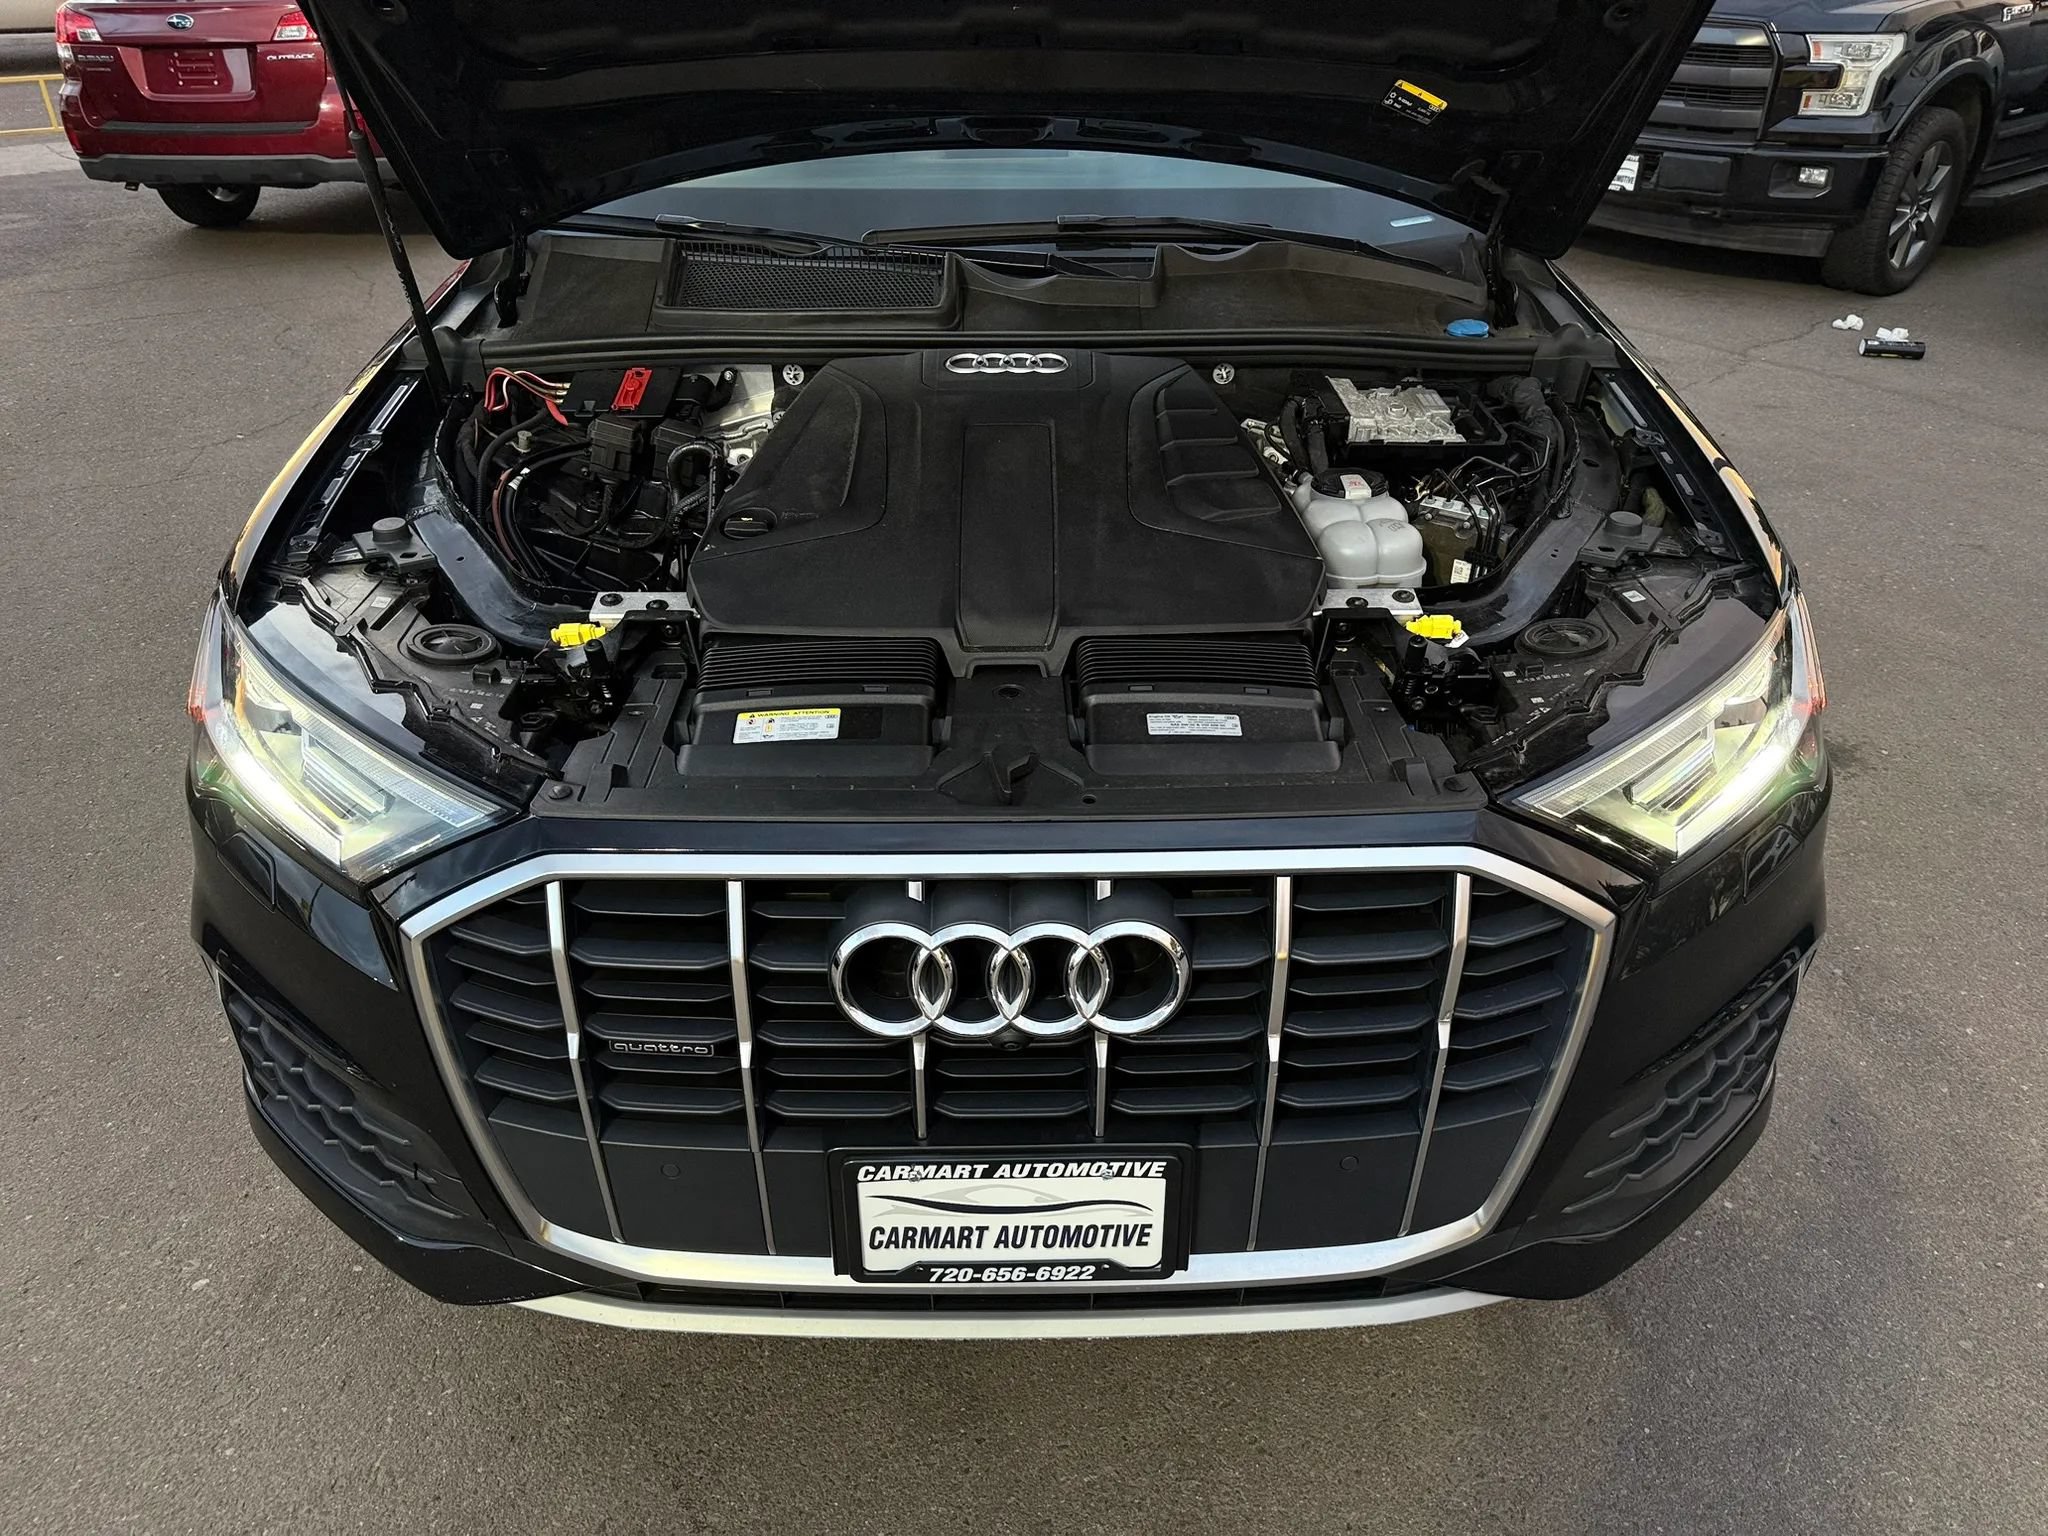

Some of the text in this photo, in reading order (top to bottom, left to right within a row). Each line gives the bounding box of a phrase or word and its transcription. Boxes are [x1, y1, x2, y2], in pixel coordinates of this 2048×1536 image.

[266, 53, 315, 61] OUTBACK
[613, 1042, 709, 1055] quattro
[857, 1161, 1168, 1181] CARMART AUTOMOTIVE
[868, 1223, 1153, 1250] CARMART AUTOMOTIVE
[929, 1265, 1096, 1282] 720-656-6922
